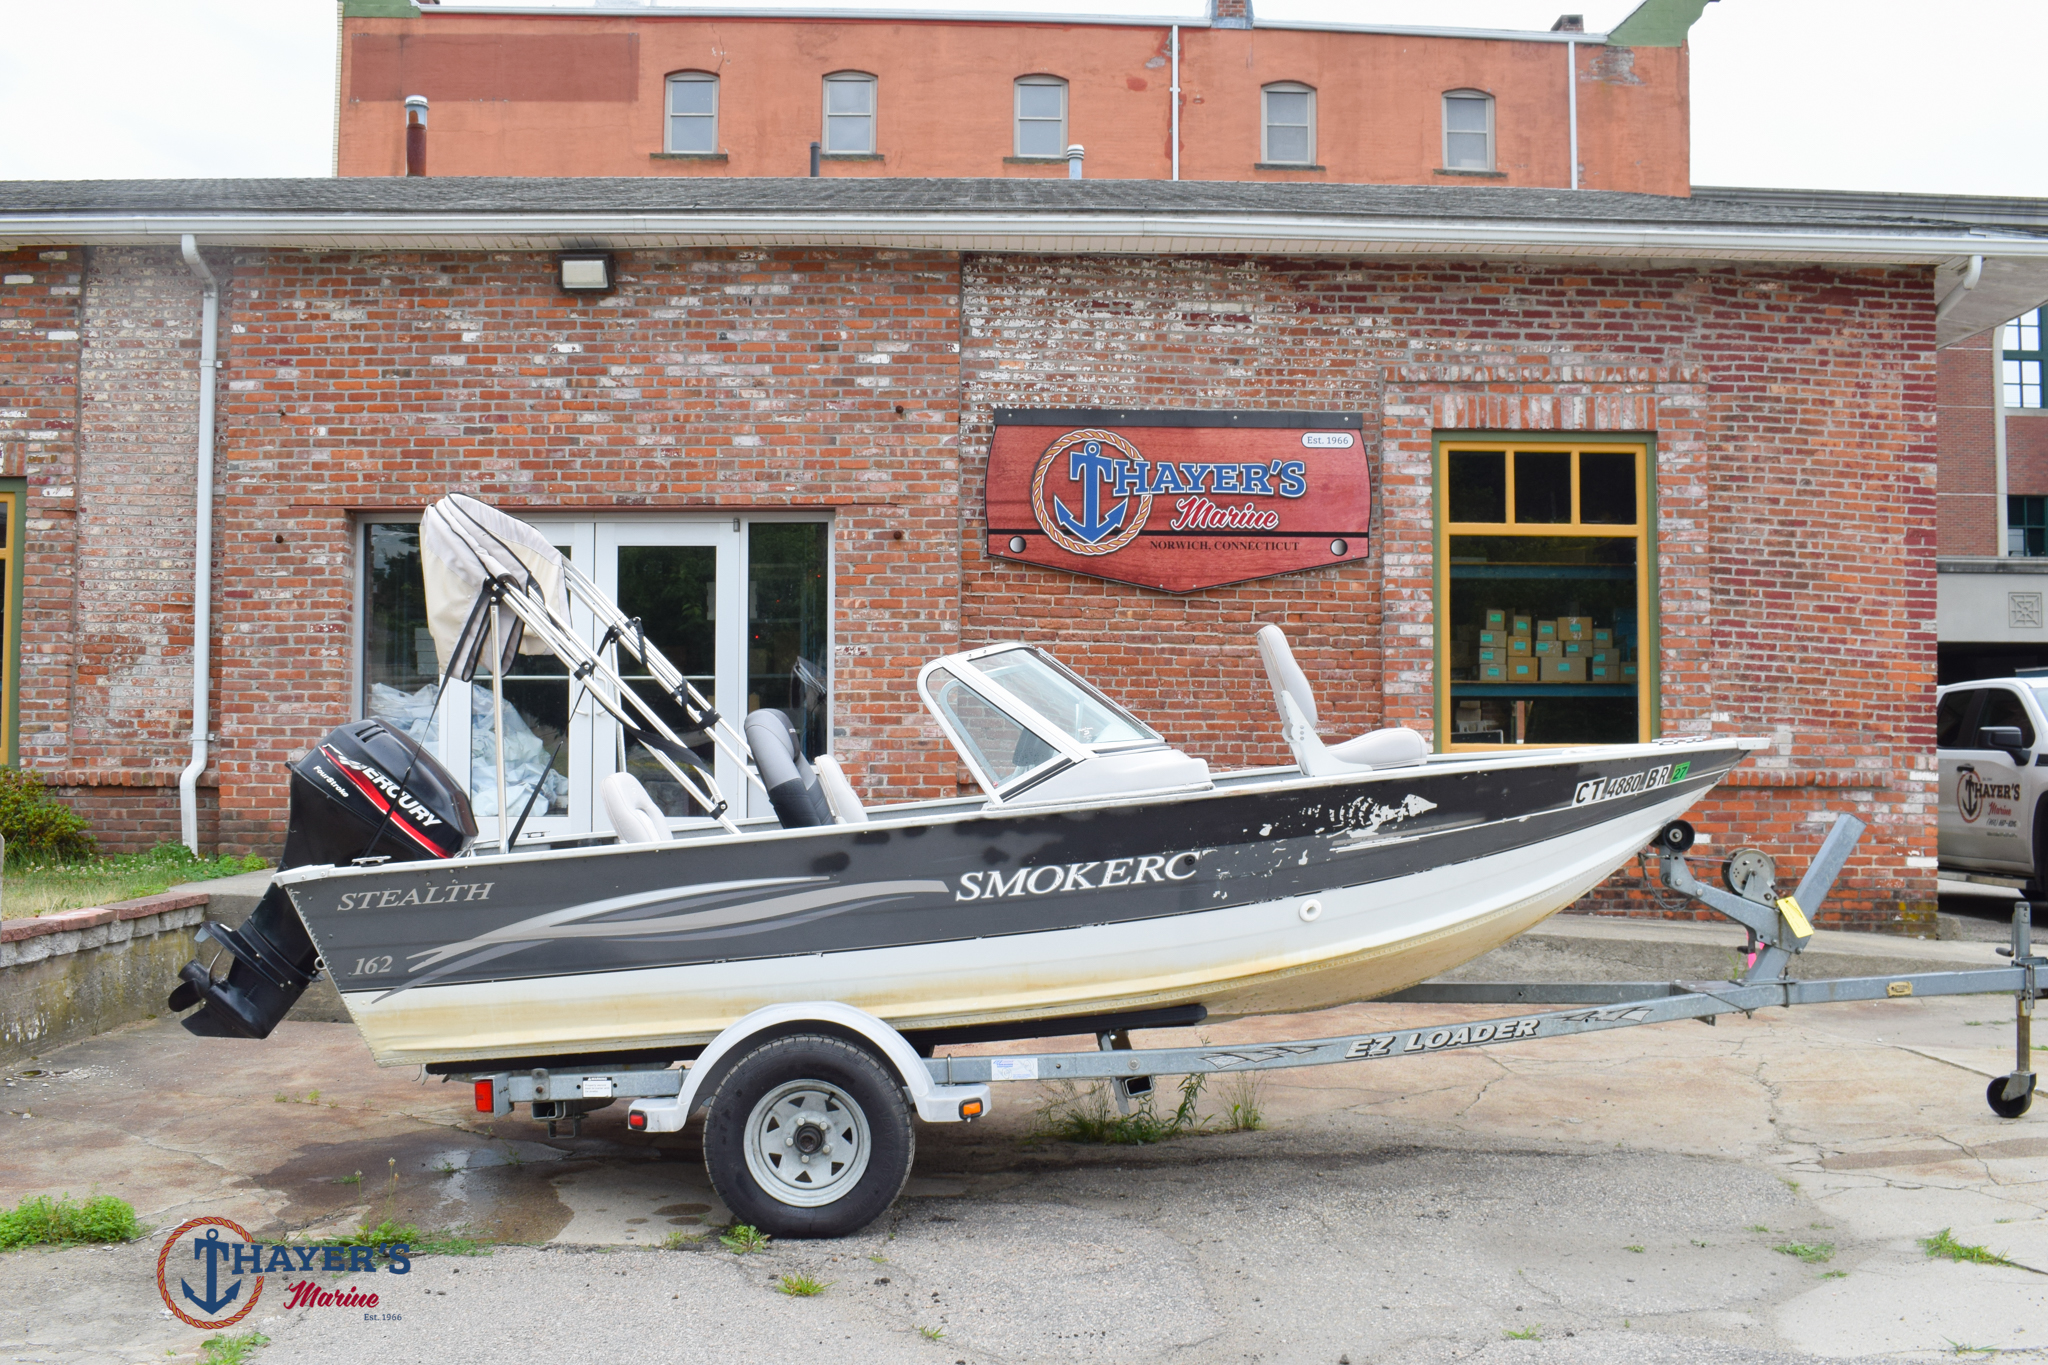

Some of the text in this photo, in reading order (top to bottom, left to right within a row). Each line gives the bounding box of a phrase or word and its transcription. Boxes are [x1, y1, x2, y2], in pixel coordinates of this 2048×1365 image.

[1307, 436, 1349, 446] Est. 1966
[1171, 496, 1279, 532] Marine
[1150, 540, 1300, 553] NORWICH, CONNECTICUT
[313, 765, 349, 798] FourStroke
[1575, 766, 1670, 804] CT 4880 BR
[1673, 766, 1688, 781] 27
[337, 882, 495, 911] STEALTH
[353, 955, 393, 976] 162
[1345, 1018, 1540, 1060] EZ LOADER
